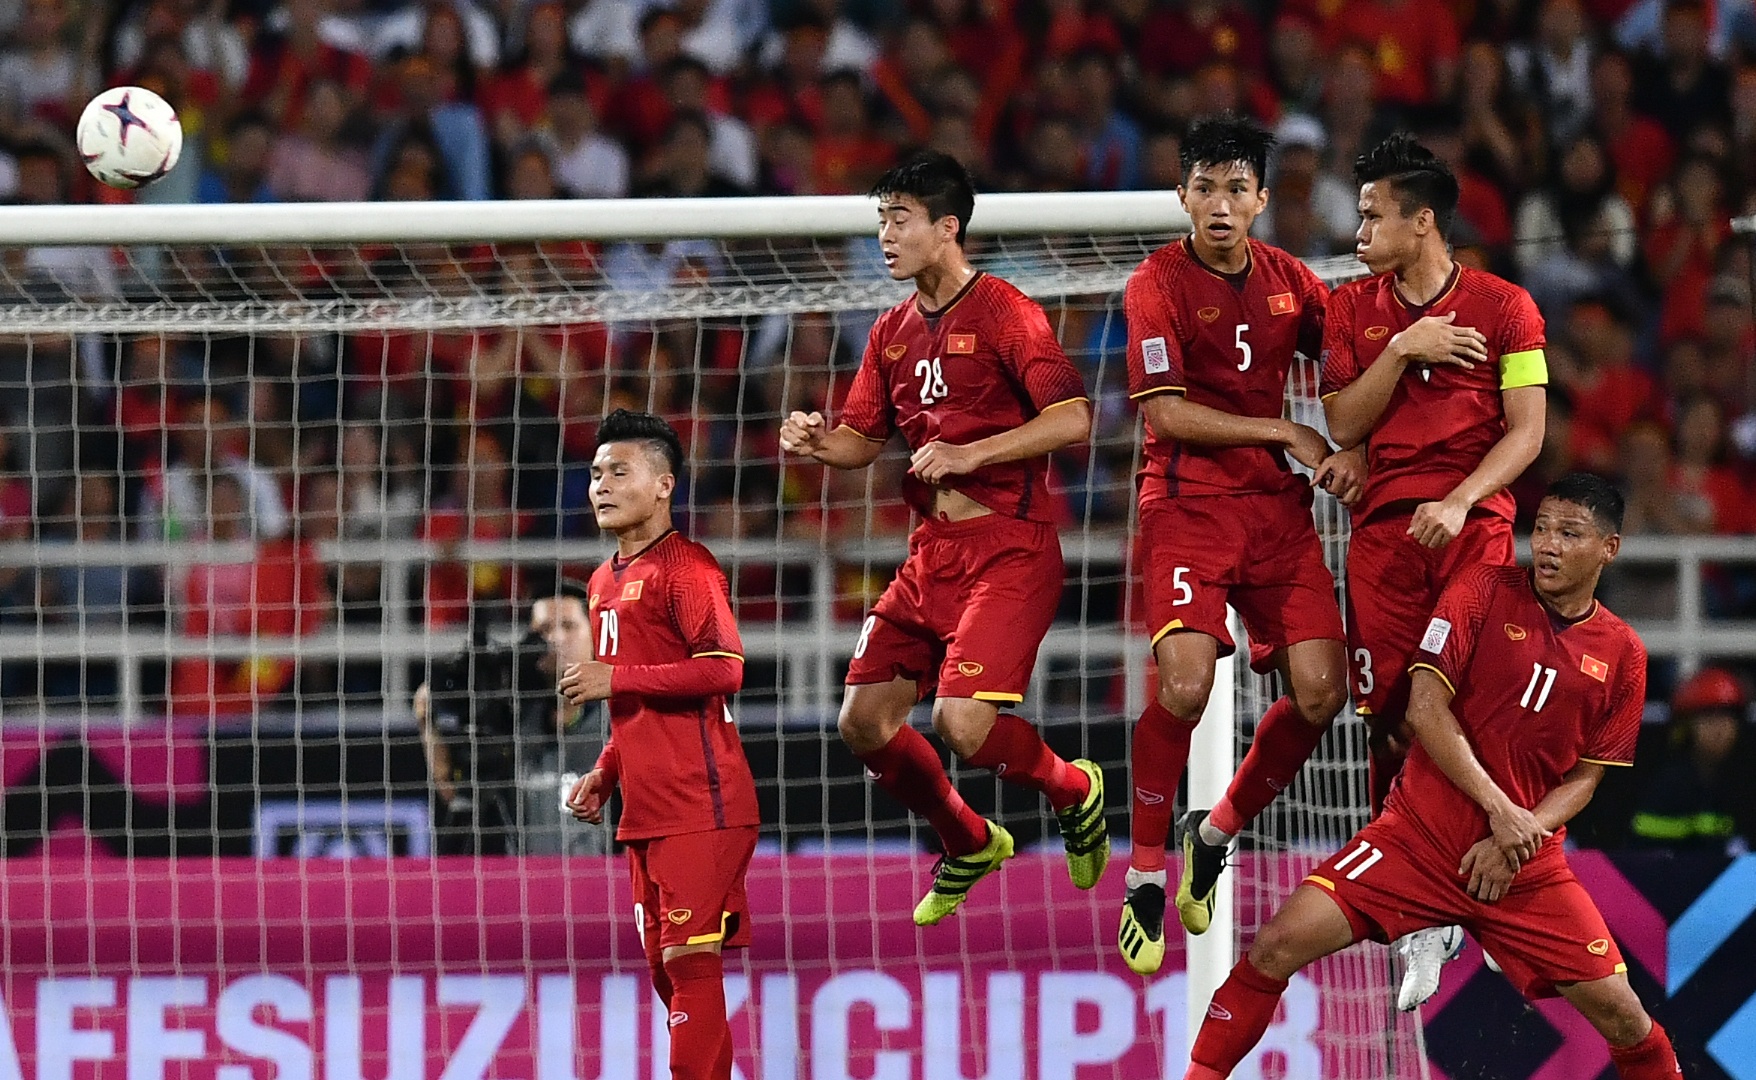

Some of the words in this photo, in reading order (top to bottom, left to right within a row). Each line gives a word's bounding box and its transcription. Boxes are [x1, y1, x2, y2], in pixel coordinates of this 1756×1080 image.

[1235, 323, 1252, 371] 5
[914, 356, 948, 405] 28
[1171, 566, 1193, 607] 5
[598, 608, 619, 657] 19
[1354, 647, 1374, 695] 3
[1520, 662, 1557, 713] 11
[1333, 839, 1383, 881] 11
